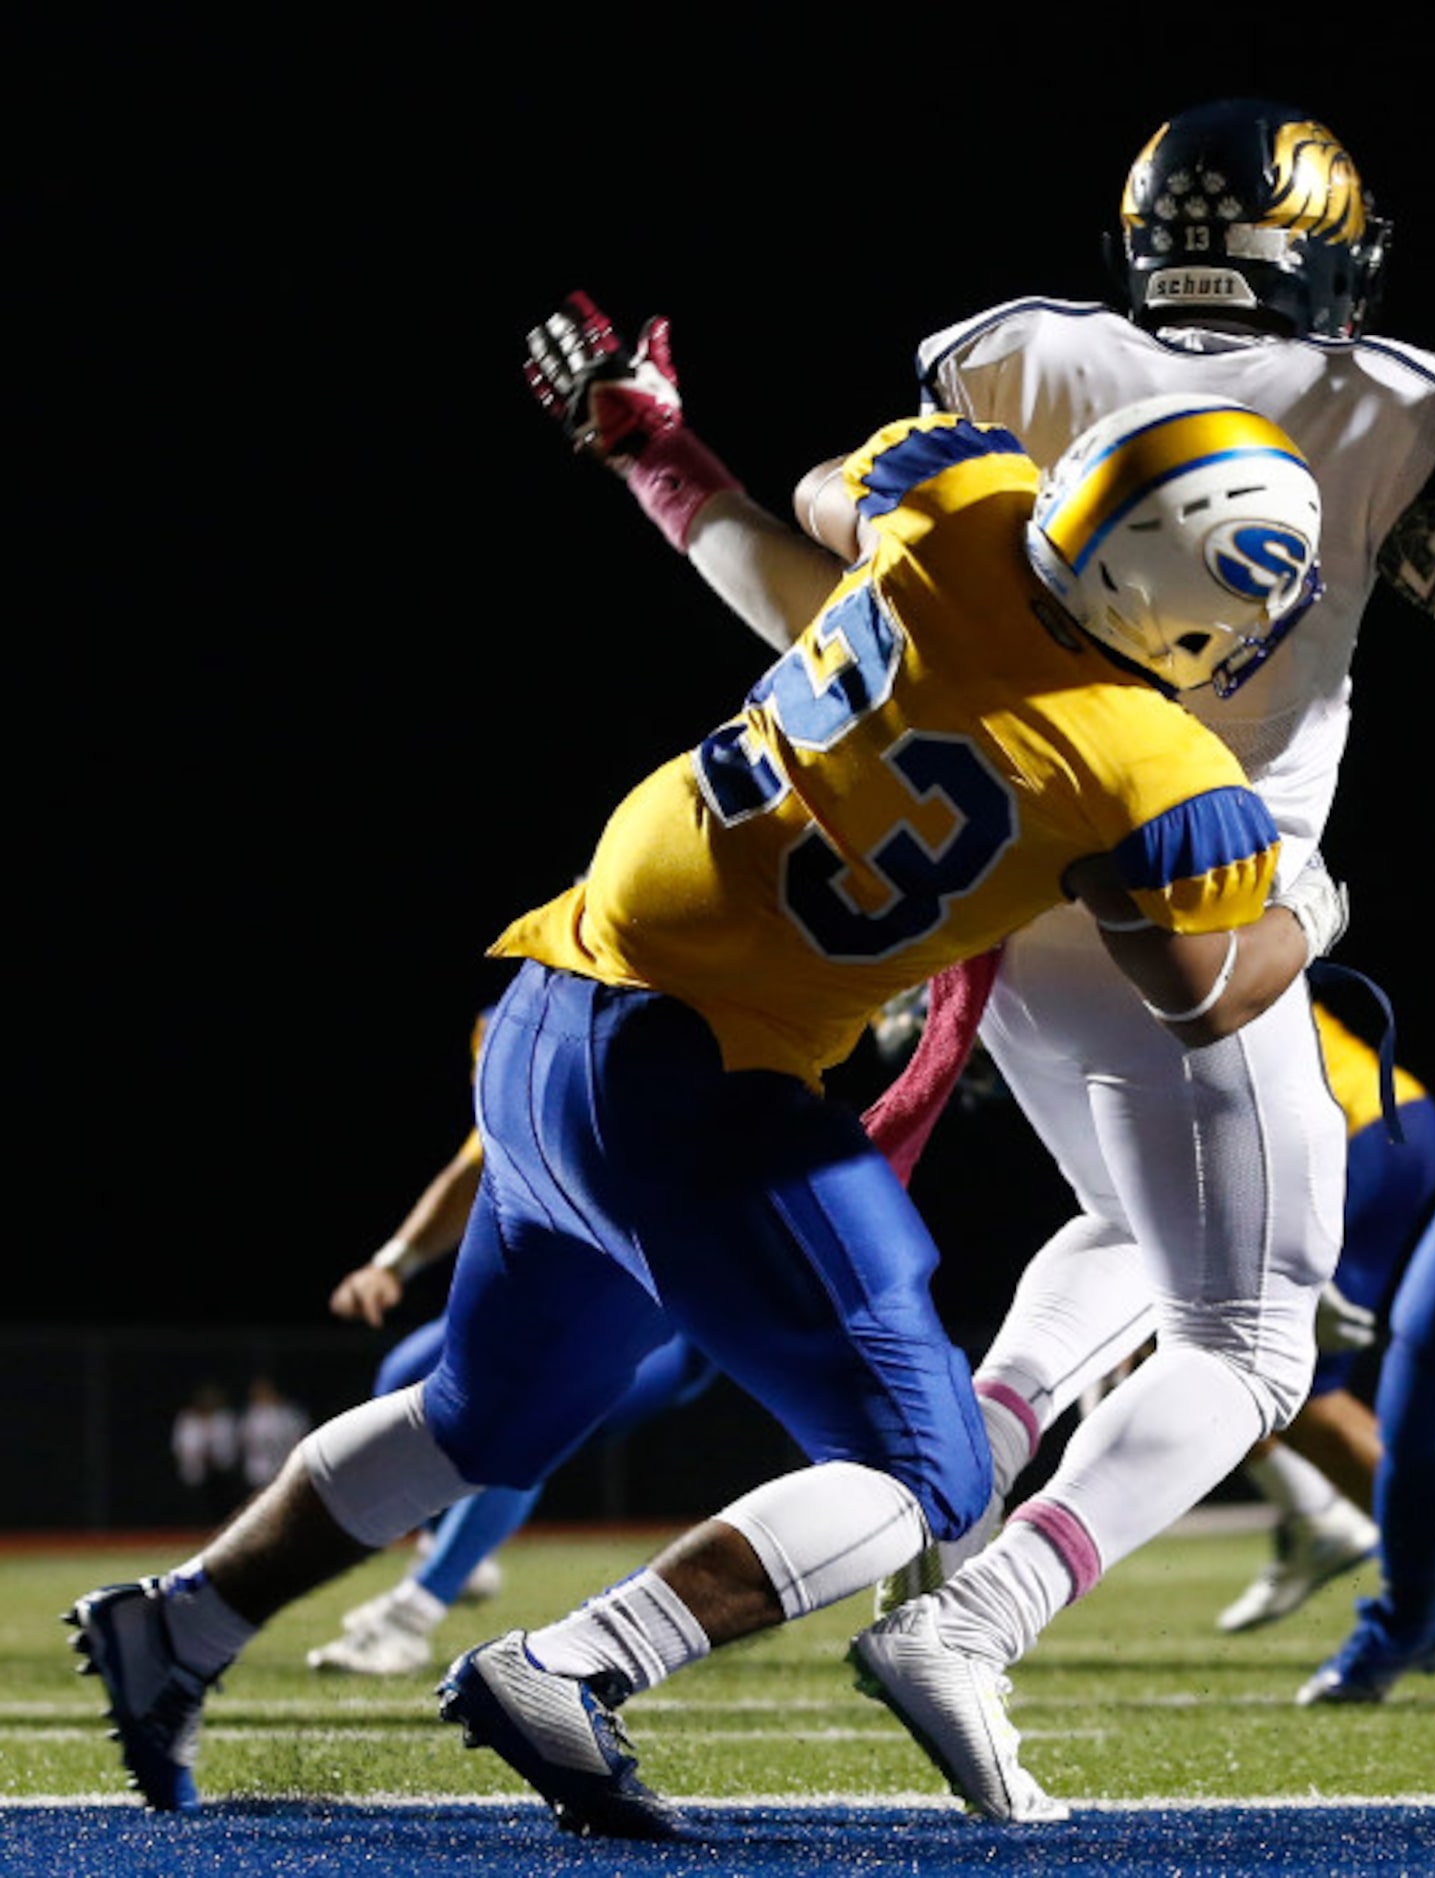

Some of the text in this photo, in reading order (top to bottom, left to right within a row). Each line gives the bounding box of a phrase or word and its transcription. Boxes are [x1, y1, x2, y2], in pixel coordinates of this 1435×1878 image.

[1184, 225, 1210, 251] 13
[1157, 273, 1233, 295] schutt
[1216, 526, 1307, 598] S
